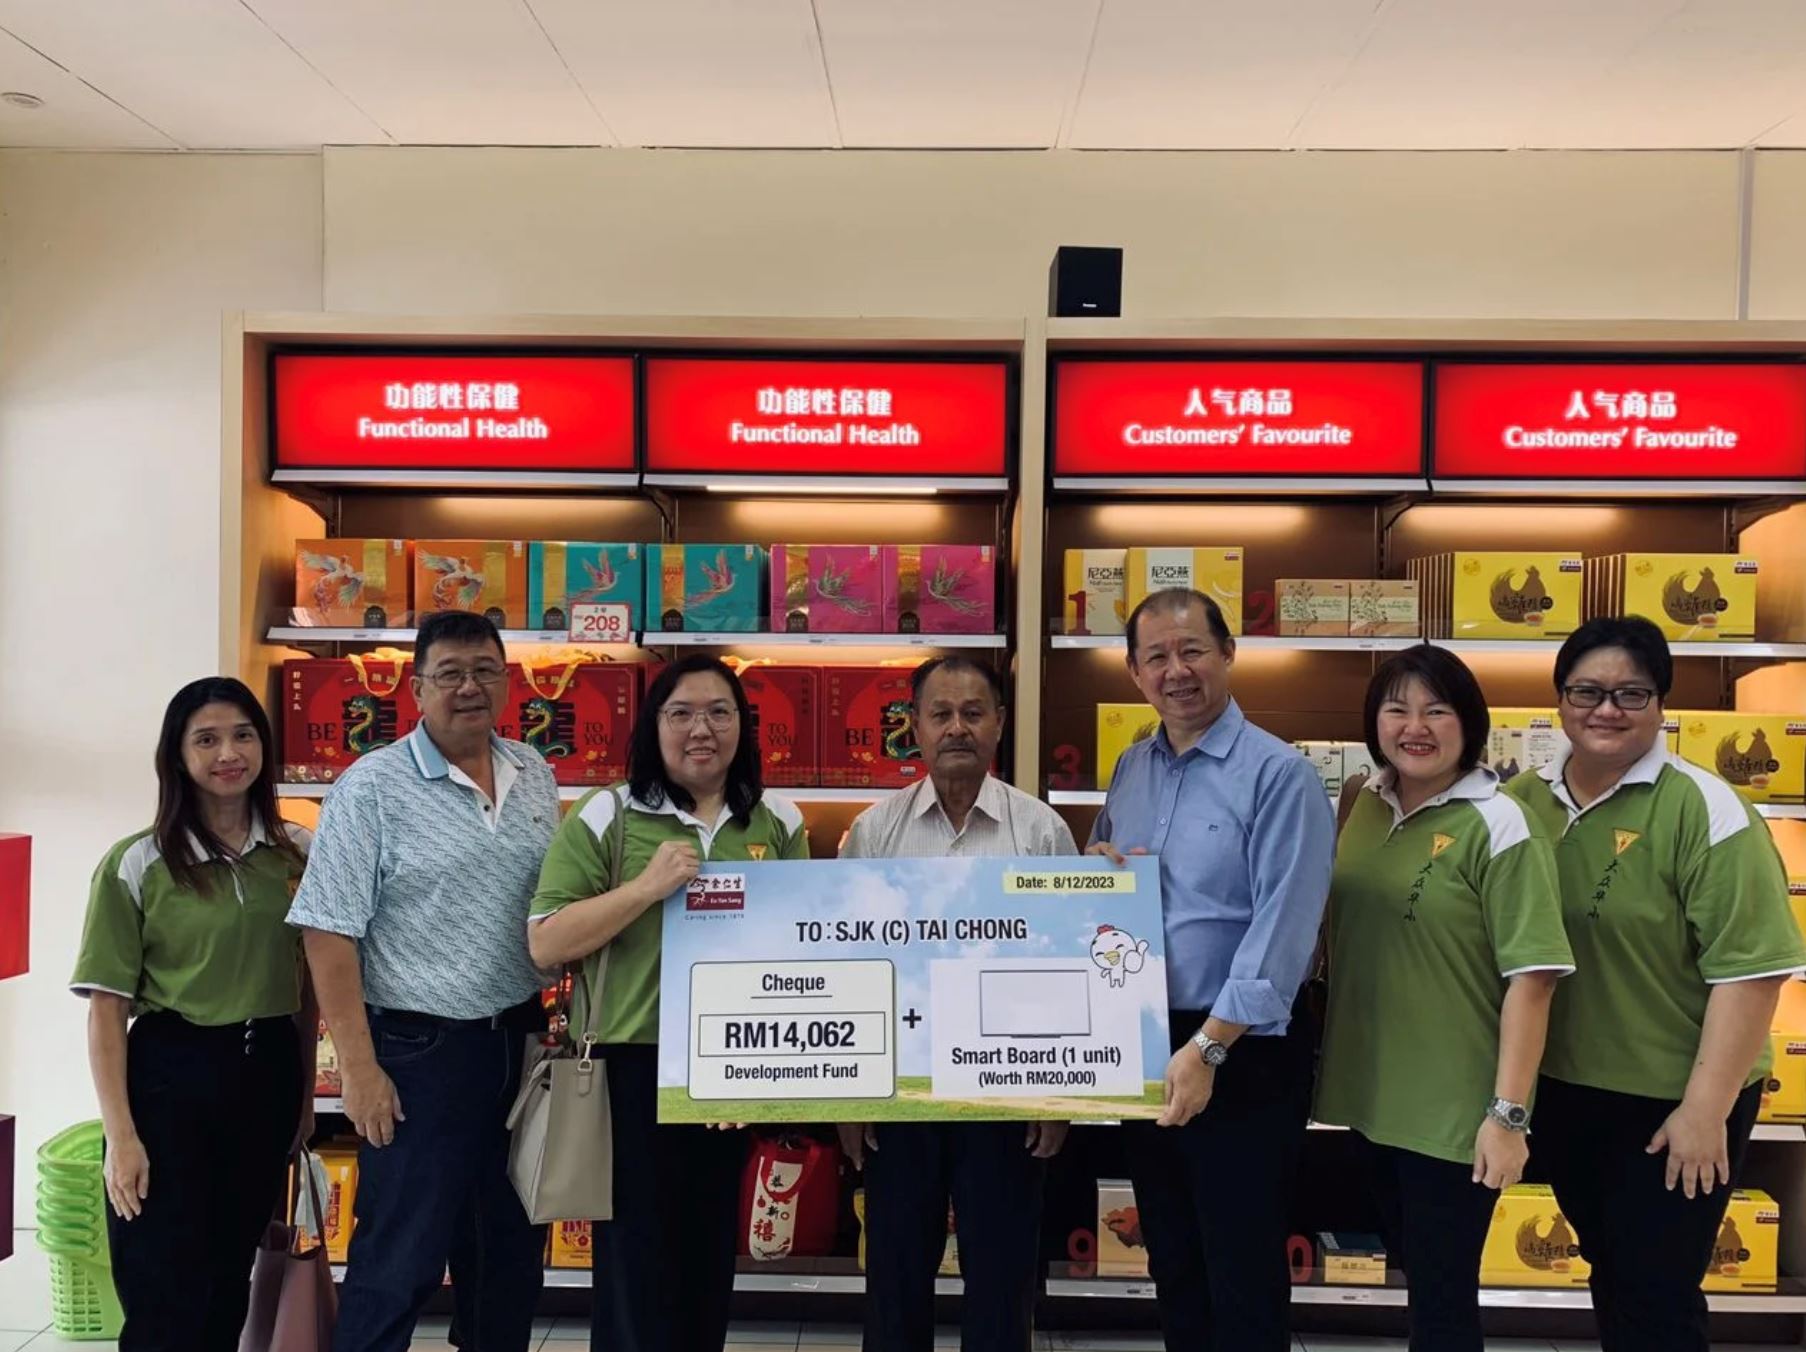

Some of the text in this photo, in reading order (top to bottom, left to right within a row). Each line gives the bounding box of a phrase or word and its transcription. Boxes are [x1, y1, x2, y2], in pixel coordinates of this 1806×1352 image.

[385, 382, 519, 411] 功能性保健
[758, 387, 892, 416] 功能性保健
[1184, 388, 1292, 416] 人气商品
[1565, 391, 1677, 419] 人气商品
[358, 418, 548, 439] Functional Health
[731, 423, 920, 445] Functional Health
[1252, 424, 1352, 445] Favourite
[1634, 427, 1737, 448] Favourite
[584, 615, 620, 631] 208
[1068, 590, 1092, 635] 1
[307, 722, 338, 741] BE
[584, 722, 604, 732] TO
[767, 722, 788, 734] TO
[845, 728, 874, 746] BE
[1016, 875, 1115, 889] Date: 8/12/2023
[882, 920, 910, 945] (C)
[916, 919, 948, 940] TAI
[955, 918, 1027, 940] CHONG
[762, 973, 825, 995] Cheque
[725, 1021, 856, 1053] RM14,062
[952, 1046, 1121, 1067] Smart Board (1 unit)
[724, 1063, 858, 1082] Development Fund
[978, 1070, 1097, 1088] (Worth RM20,000)
